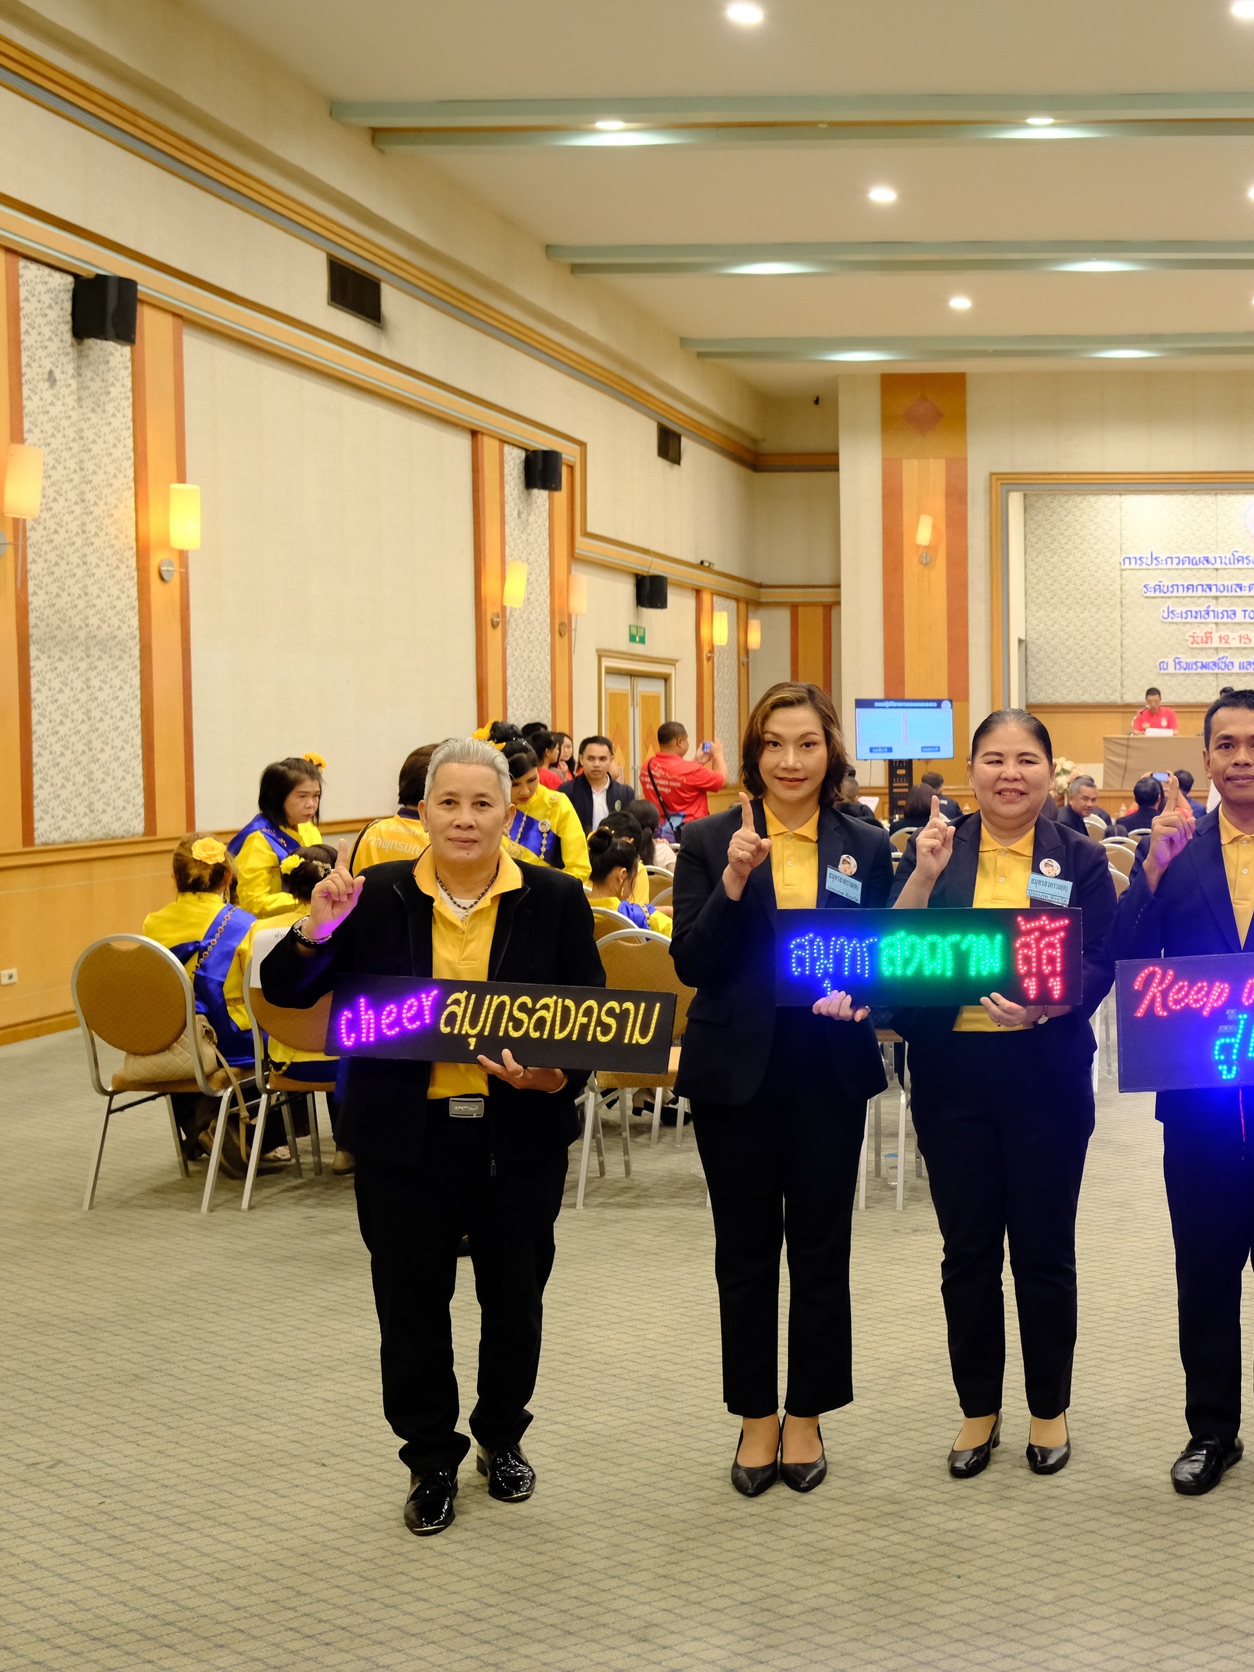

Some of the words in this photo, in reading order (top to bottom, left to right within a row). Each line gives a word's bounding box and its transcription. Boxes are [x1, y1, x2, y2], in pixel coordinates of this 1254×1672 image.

[1161, 605, 1237, 620] ประเภทอำเภอ
[339, 987, 440, 1049] cheer
[438, 989, 661, 1051] สมุทรสงคราม
[1132, 965, 1232, 1019] Keep
